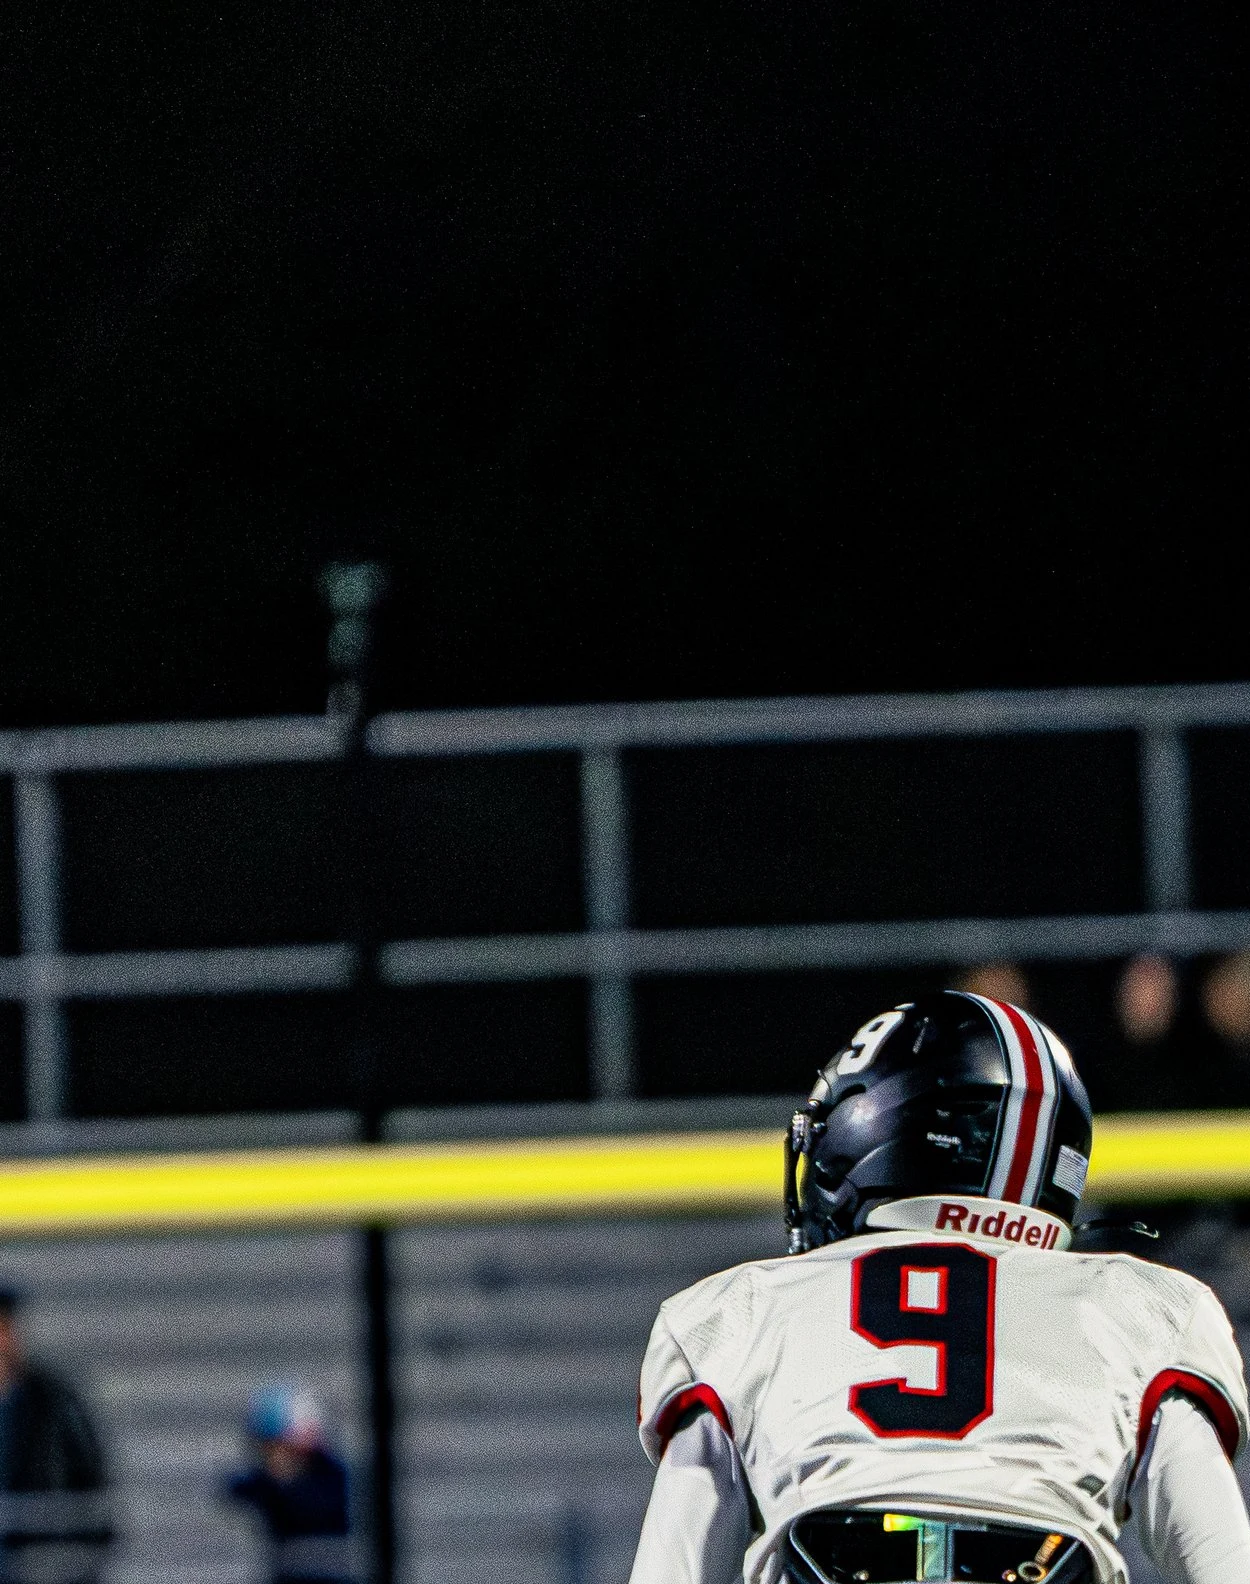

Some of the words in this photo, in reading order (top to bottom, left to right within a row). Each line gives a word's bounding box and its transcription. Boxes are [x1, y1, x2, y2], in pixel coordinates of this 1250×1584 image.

[837, 1010, 905, 1075] 9
[935, 1202, 1060, 1250] Riddell
[848, 1243, 998, 1440] 9
